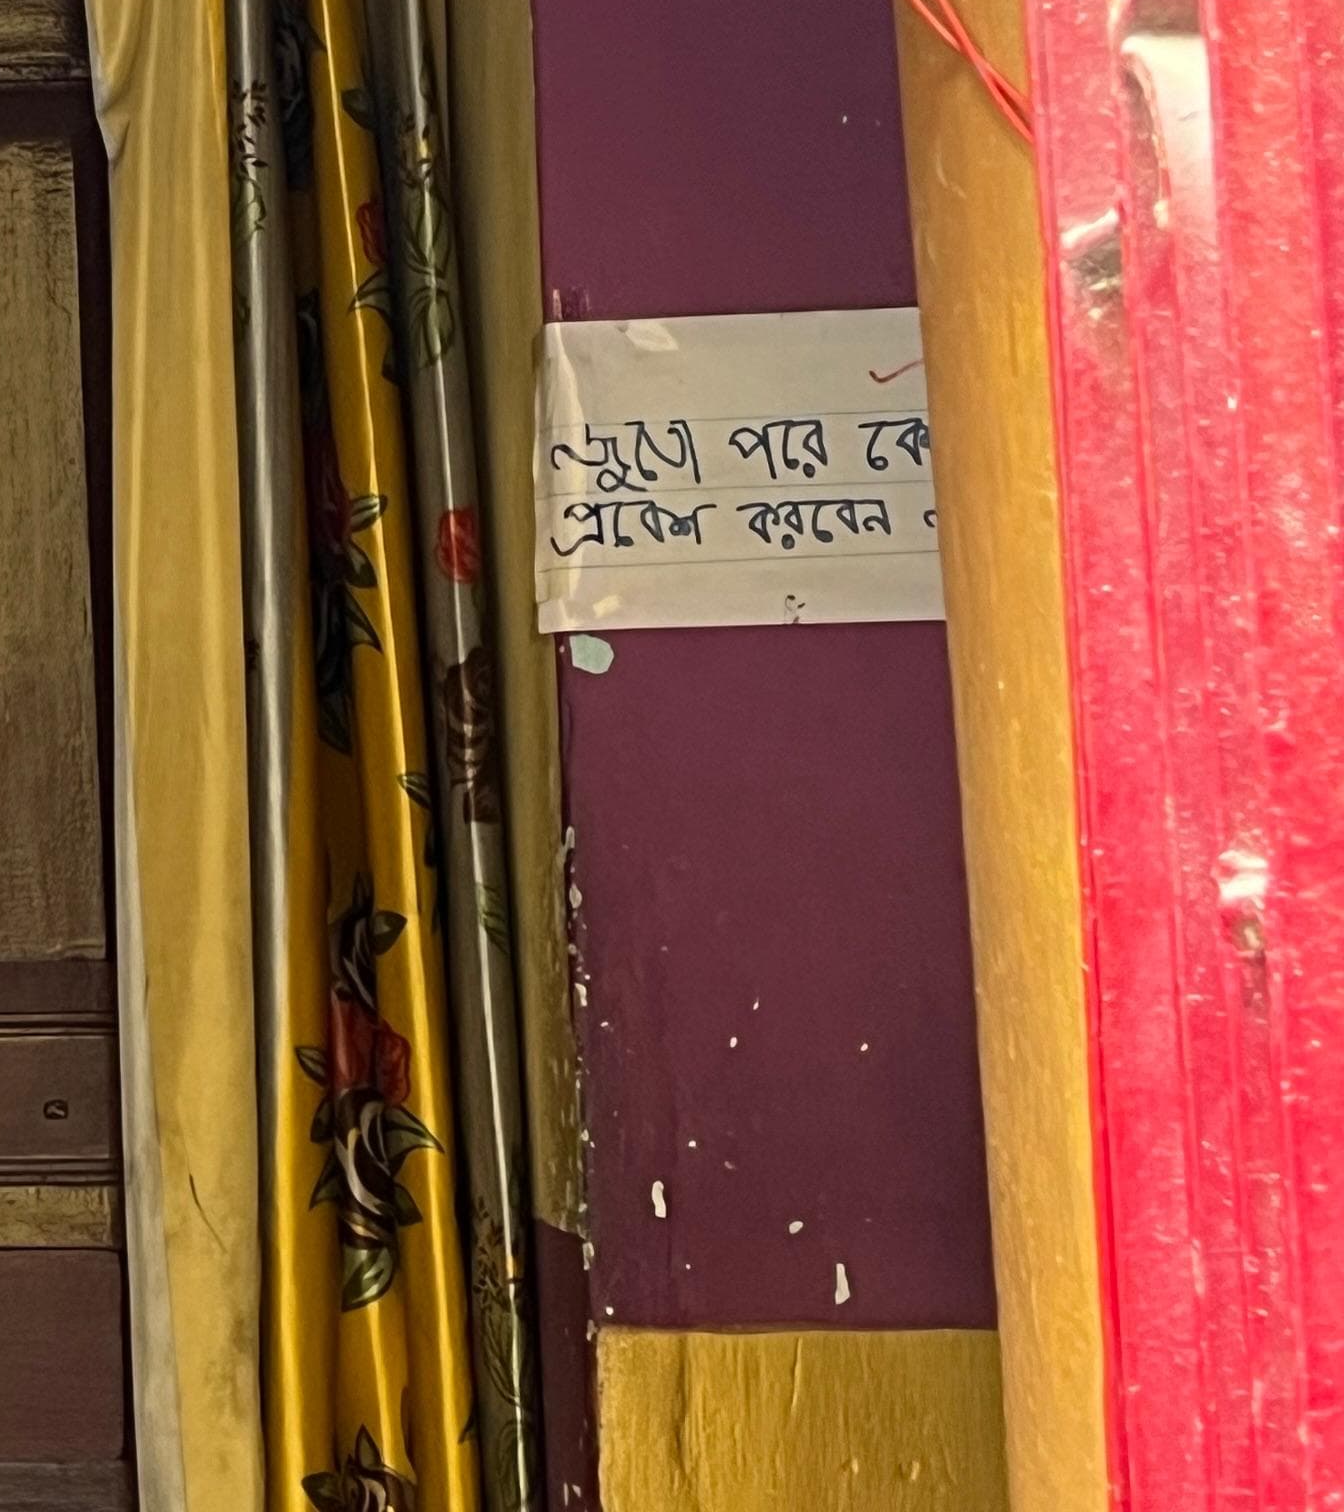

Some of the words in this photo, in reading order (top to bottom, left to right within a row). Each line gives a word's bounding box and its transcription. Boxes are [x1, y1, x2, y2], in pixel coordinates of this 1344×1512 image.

[728, 418, 828, 480] পরে
[550, 500, 718, 557] প্রবেশ
[734, 498, 892, 550] করবেন
